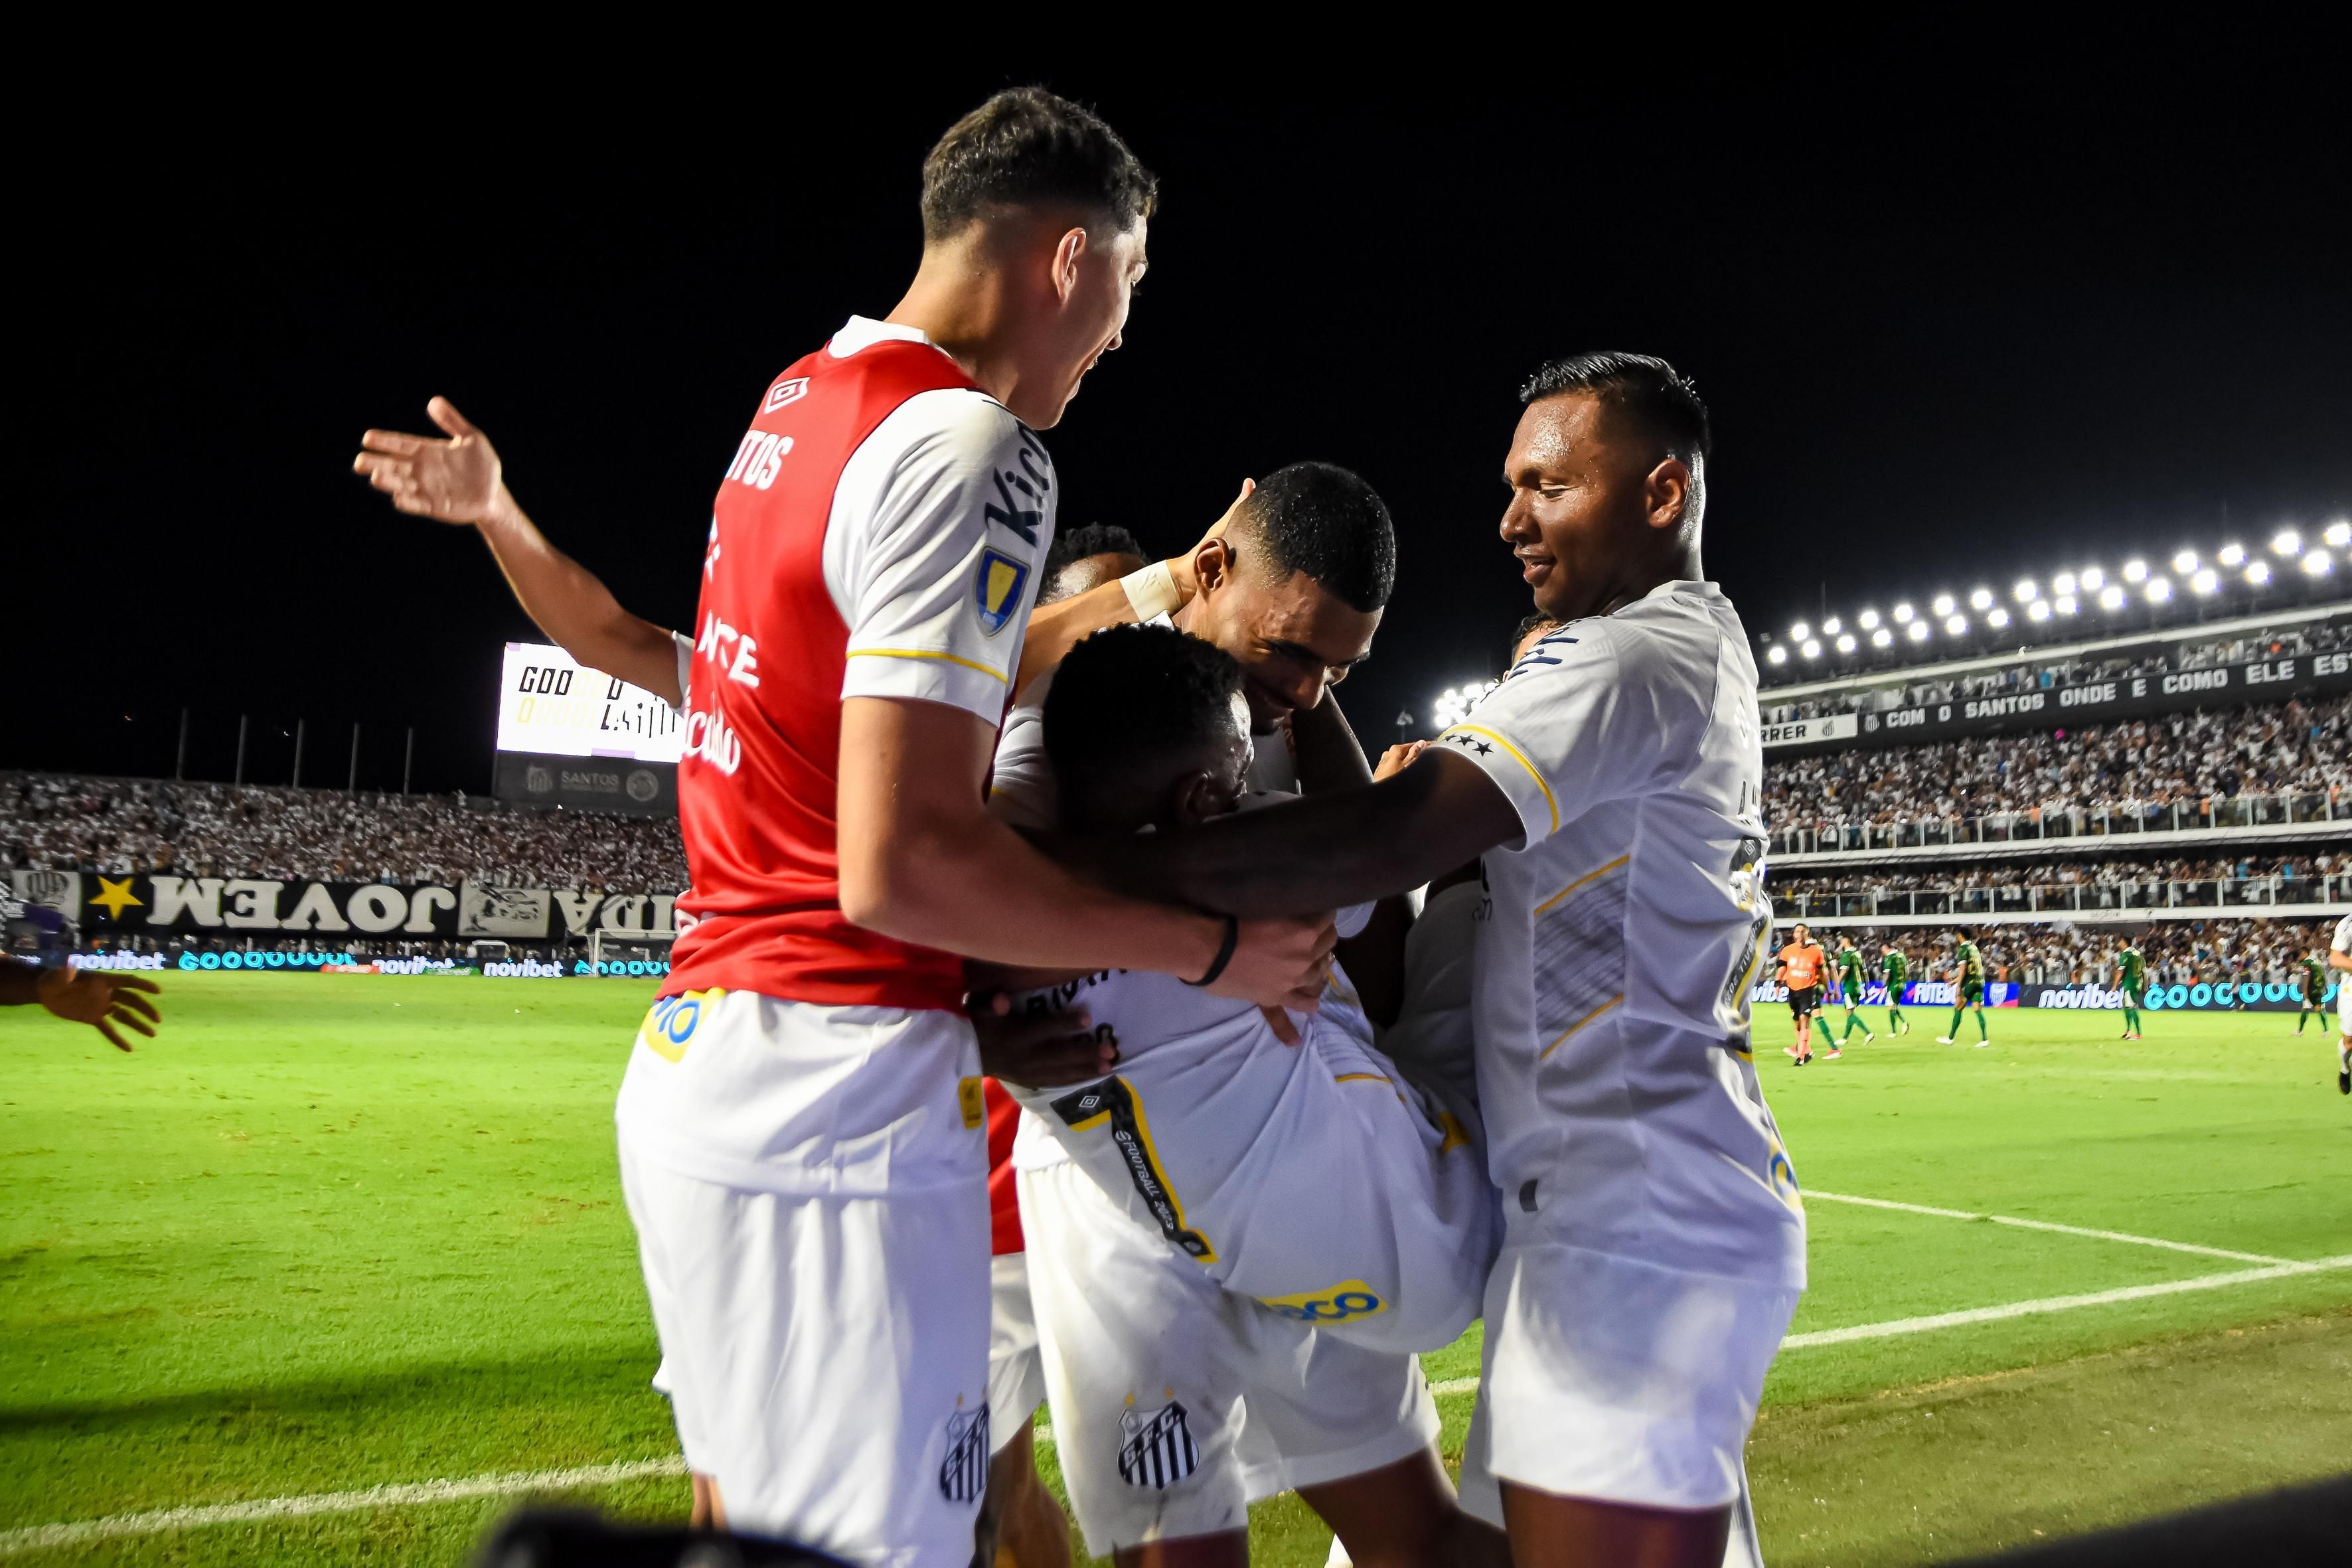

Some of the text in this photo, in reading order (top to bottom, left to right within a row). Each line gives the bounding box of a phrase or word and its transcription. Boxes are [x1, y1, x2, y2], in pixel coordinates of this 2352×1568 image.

[1886, 708, 1925, 728] COM
[1938, 705, 1952, 722] O
[1964, 693, 2045, 719] SANTOS
[2059, 683, 2117, 707] ONDE
[2132, 678, 2147, 698] E
[2162, 668, 2229, 694] COMO
[2246, 660, 2296, 685] ELE
[561, 771, 620, 785] SANTOS
[146, 876, 456, 933] JOVEM
[68, 949, 166, 970] novibet
[483, 957, 563, 978] novibet
